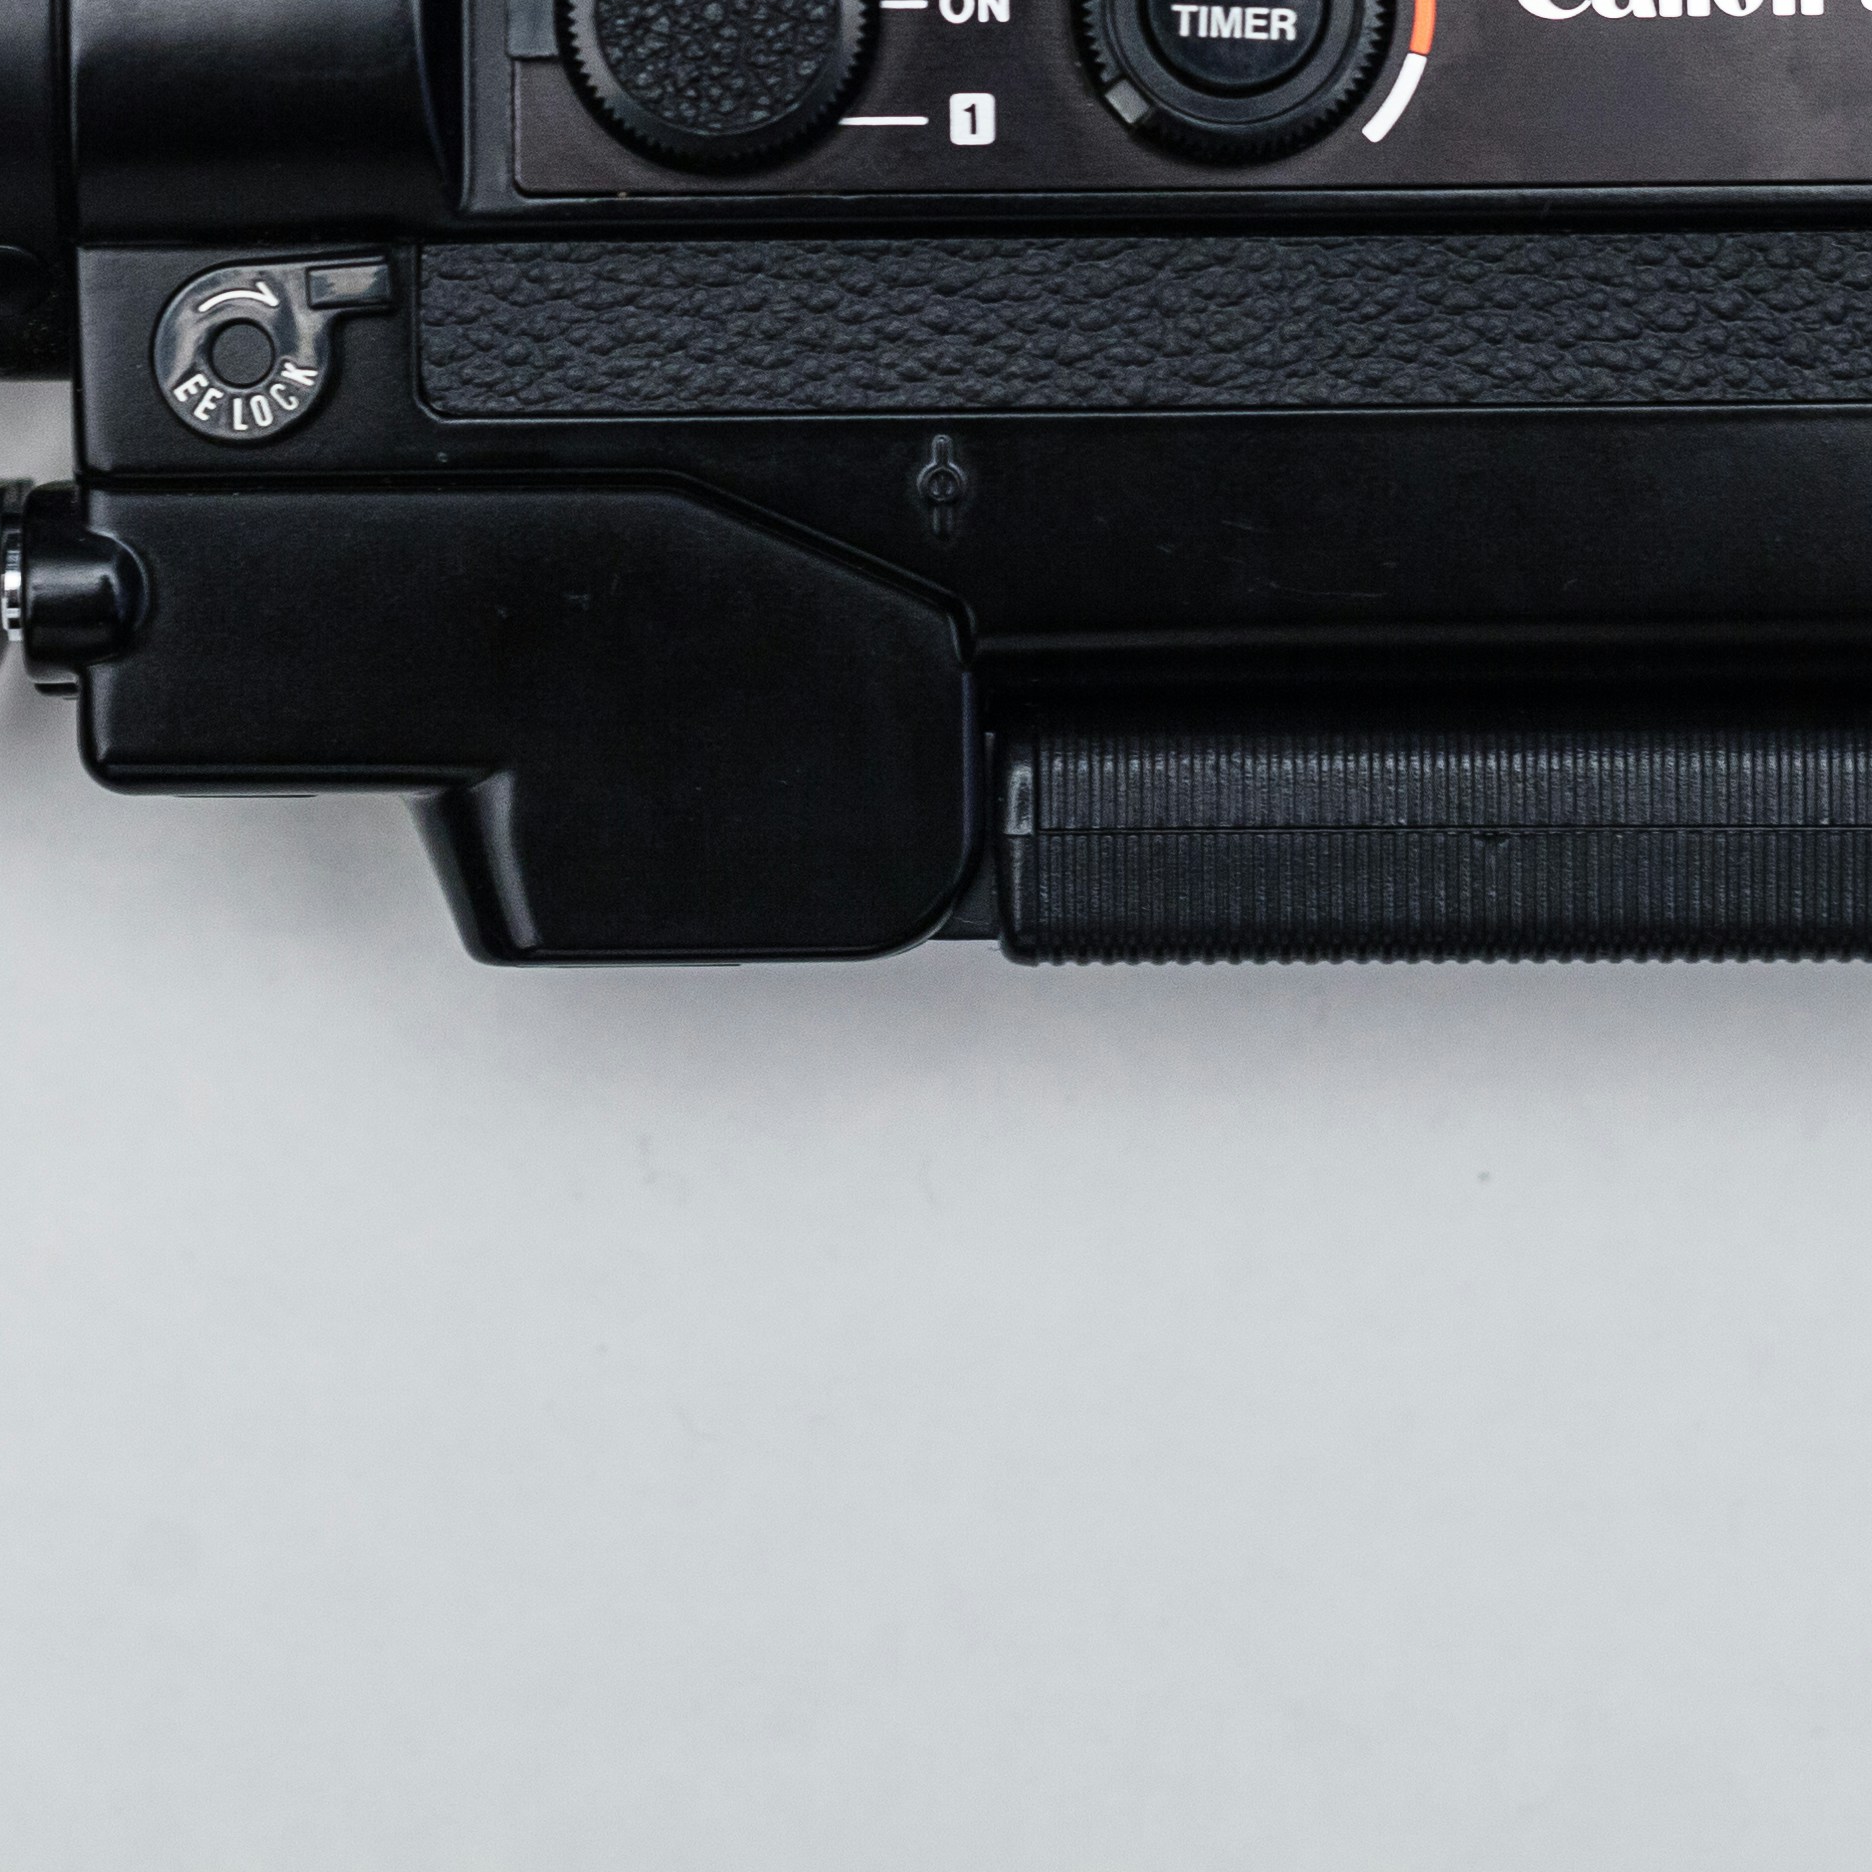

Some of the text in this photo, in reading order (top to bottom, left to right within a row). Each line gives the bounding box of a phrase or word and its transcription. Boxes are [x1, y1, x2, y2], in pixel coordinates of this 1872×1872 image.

[1171, 4, 1298, 42] TIMER
[962, 102, 978, 136] 1
[173, 361, 319, 432] EE LOCK
